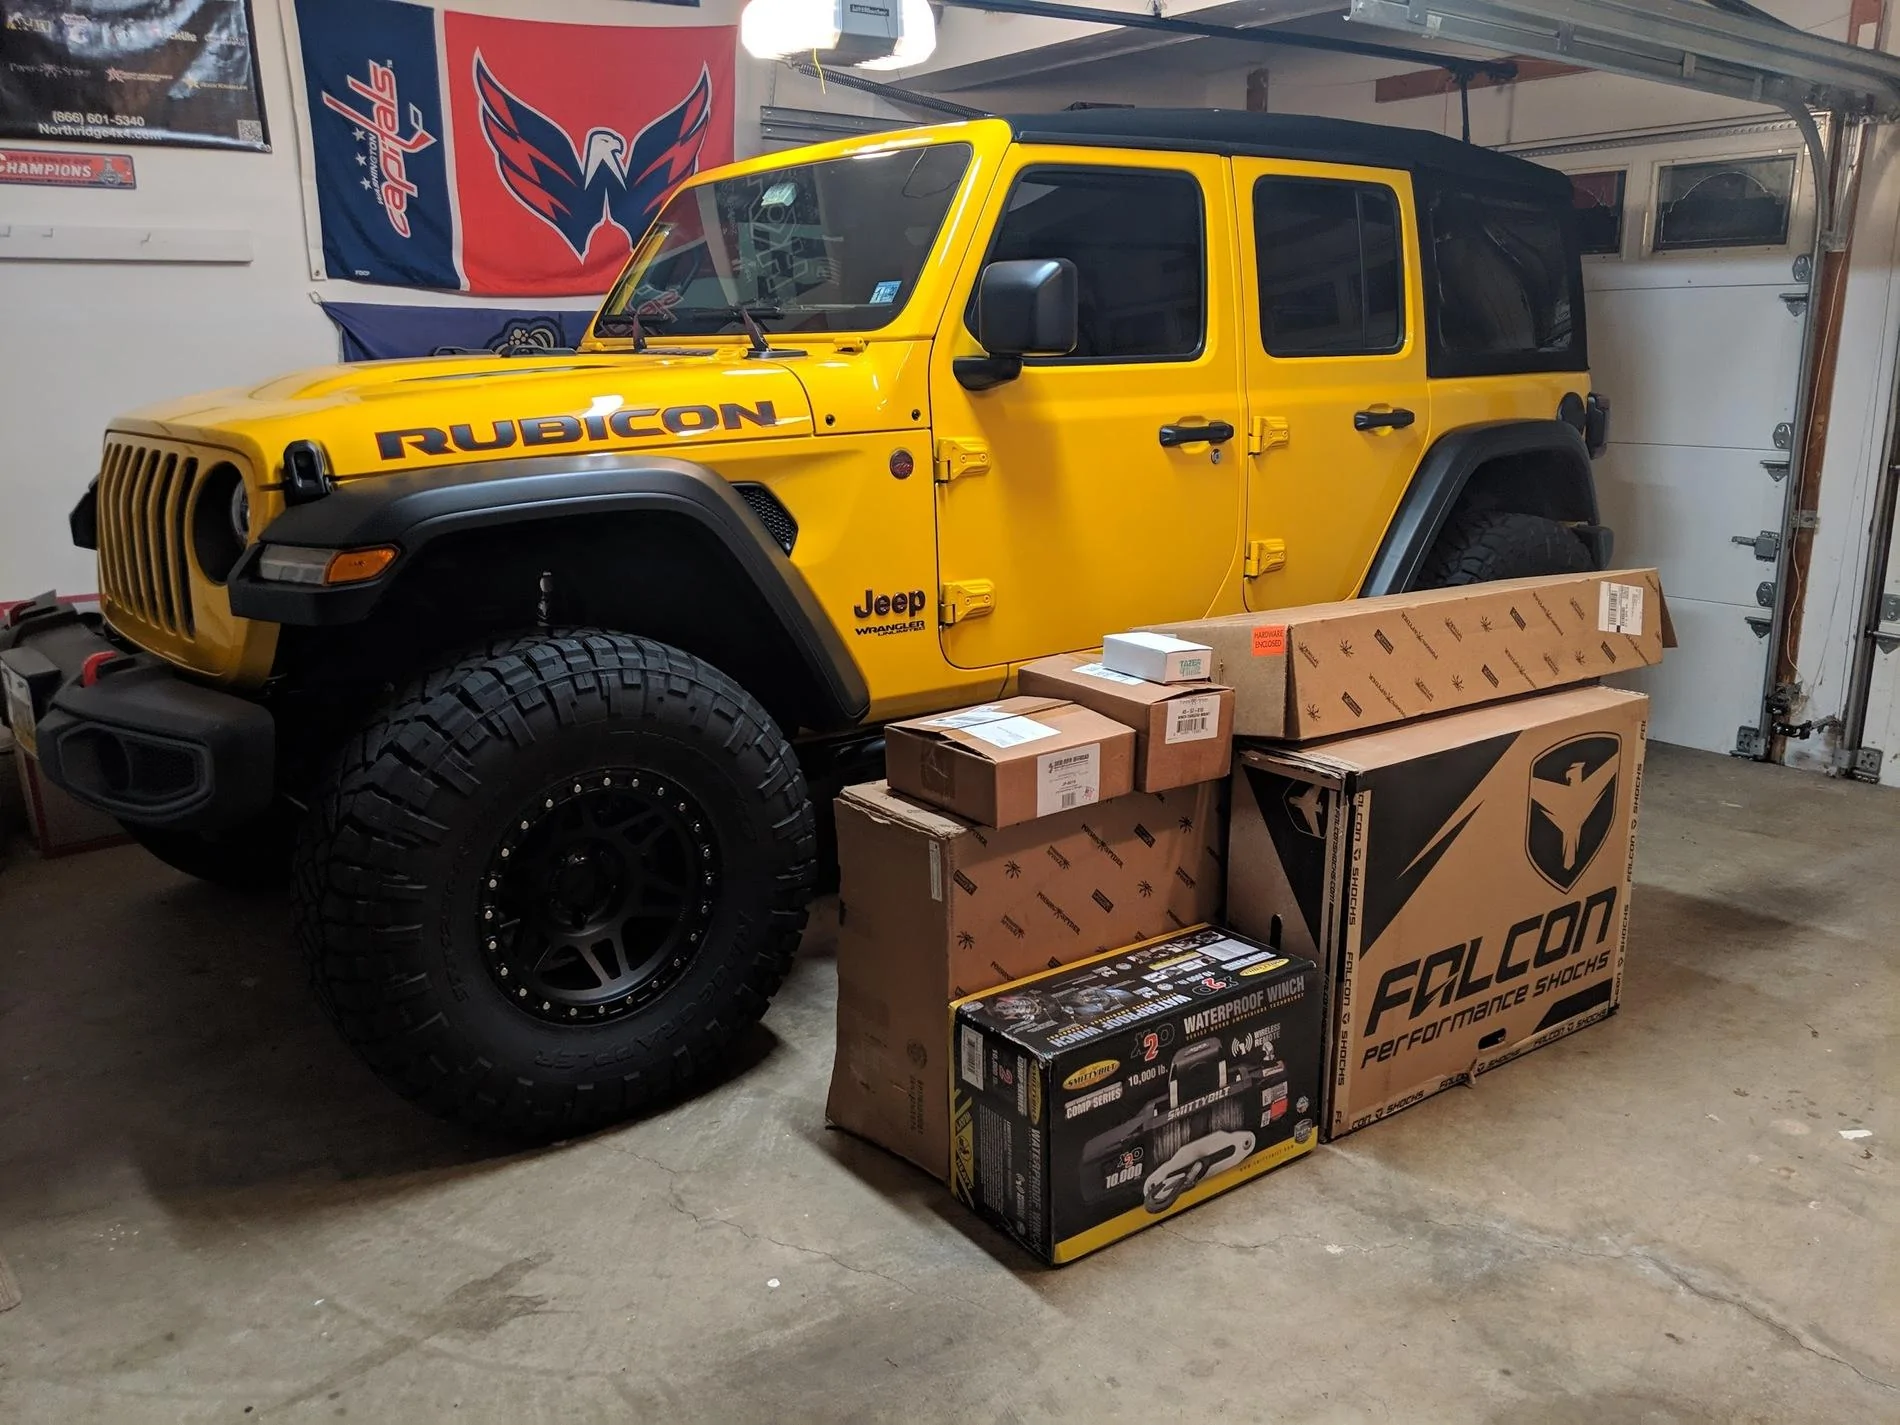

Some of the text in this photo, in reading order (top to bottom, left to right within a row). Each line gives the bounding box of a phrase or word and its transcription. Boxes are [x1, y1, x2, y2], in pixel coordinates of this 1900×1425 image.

[38, 123, 163, 141] Northridge4x4.com
[52, 110, 145, 127] (866) 601-5340
[366, 132, 385, 206] WASHINGTON
[375, 400, 778, 460] RUBICON
[854, 590, 926, 619] Jeep
[855, 620, 925, 636] WRANGLER
[877, 627, 925, 637] UNLIMITED
[1255, 629, 1284, 640] HARDWARE
[1255, 640, 1282, 649] ENCLOSED
[1081, 823, 1124, 869] POISON SPYDER
[1627, 834, 1636, 883] FALCON
[1036, 891, 1080, 936] POISON SPYDER
[1364, 886, 1617, 1038] FALCON
[1343, 951, 1354, 1007] FALCON
[1102, 994, 1193, 1030] WATERPROOF
[1184, 992, 1264, 1034] WATERPROOF
[1267, 976, 1305, 1003] WINCH
[1048, 1025, 1104, 1048] WINCH
[1254, 1023, 1281, 1039] WIRELESS
[1254, 1031, 1281, 1047] REMOTE
[1068, 1063, 1117, 1086] SMITTYBILT
[1128, 1064, 1168, 1087] 10,000 lb.
[1066, 1089, 1122, 1119] COMP SERIES
[1168, 1086, 1231, 1121] SMITTYBILT
[1031, 1128, 1041, 1208] WATERPROOF
